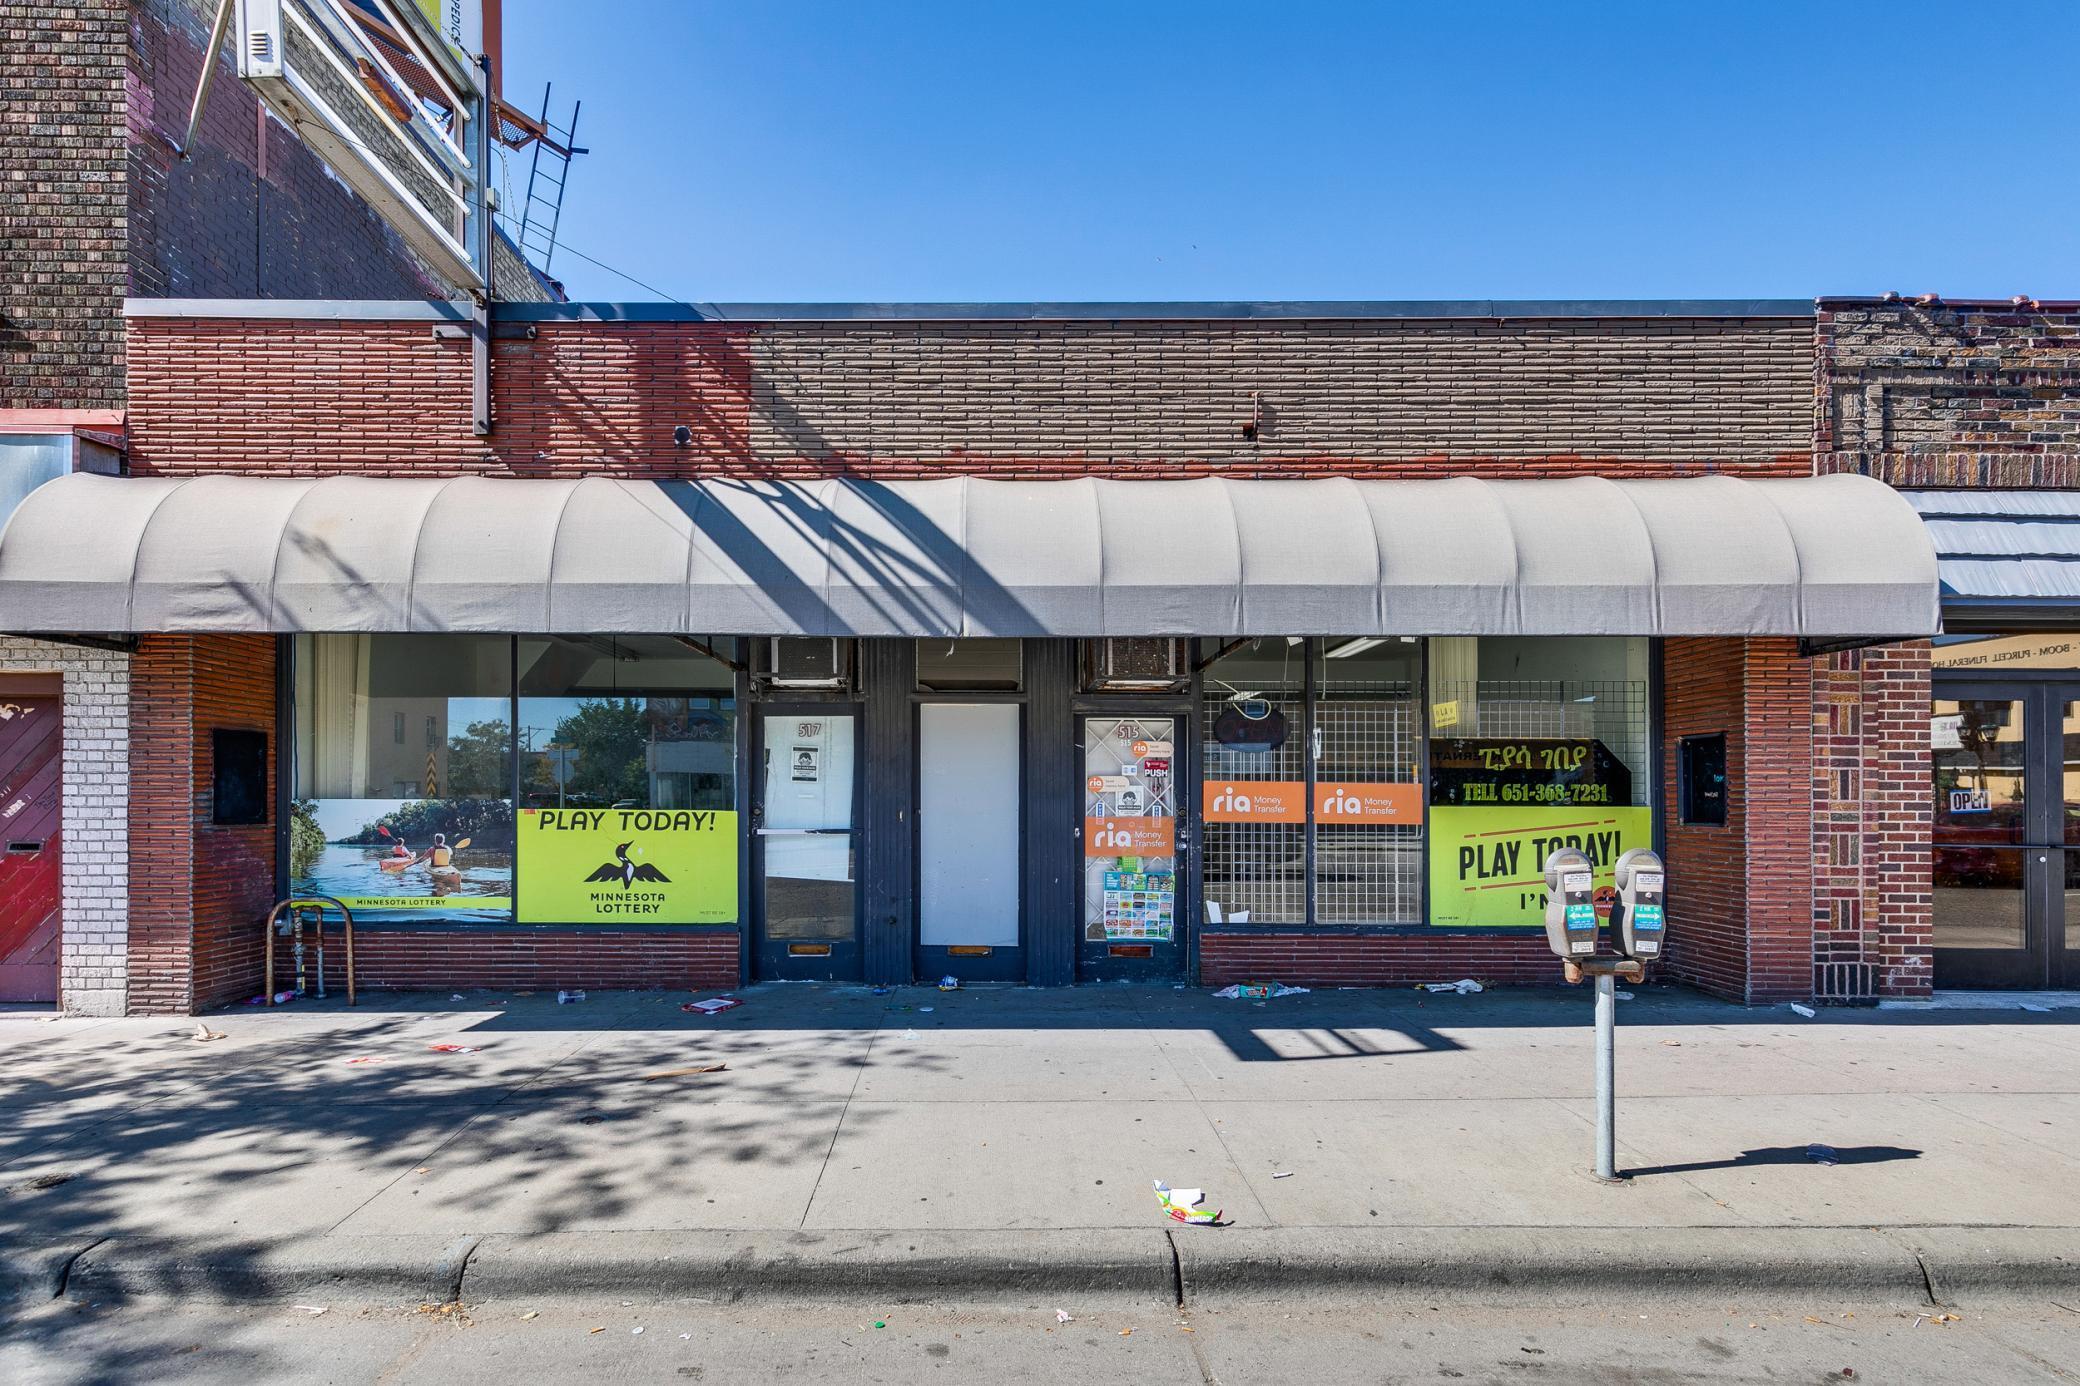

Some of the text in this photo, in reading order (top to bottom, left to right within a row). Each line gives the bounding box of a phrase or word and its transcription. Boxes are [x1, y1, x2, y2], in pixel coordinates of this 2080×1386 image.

[798, 723, 822, 737] 517
[1117, 725, 1140, 739] 515
[1133, 743, 1147, 752] ria
[1144, 769, 1168, 777] PUSH
[1089, 777, 1102, 787] ria
[1463, 783, 1608, 802] TELL 651-368-7231
[1213, 786, 1251, 813] ria
[1254, 795, 1282, 805] Money
[1323, 788, 1361, 814] ria
[1364, 798, 1393, 807] Money
[1953, 793, 1989, 810] OPEN
[1254, 804, 1287, 814] Transfer
[1364, 806, 1397, 815] Transfer
[539, 811, 716, 831] PLAY TODAY!
[1094, 822, 1132, 848] ria
[1134, 831, 1162, 840] Money
[1134, 839, 1168, 848] Transfer
[1459, 840, 1522, 880] PLAY
[590, 893, 666, 902] MINNESOTA
[596, 904, 661, 913] LOTTERY
